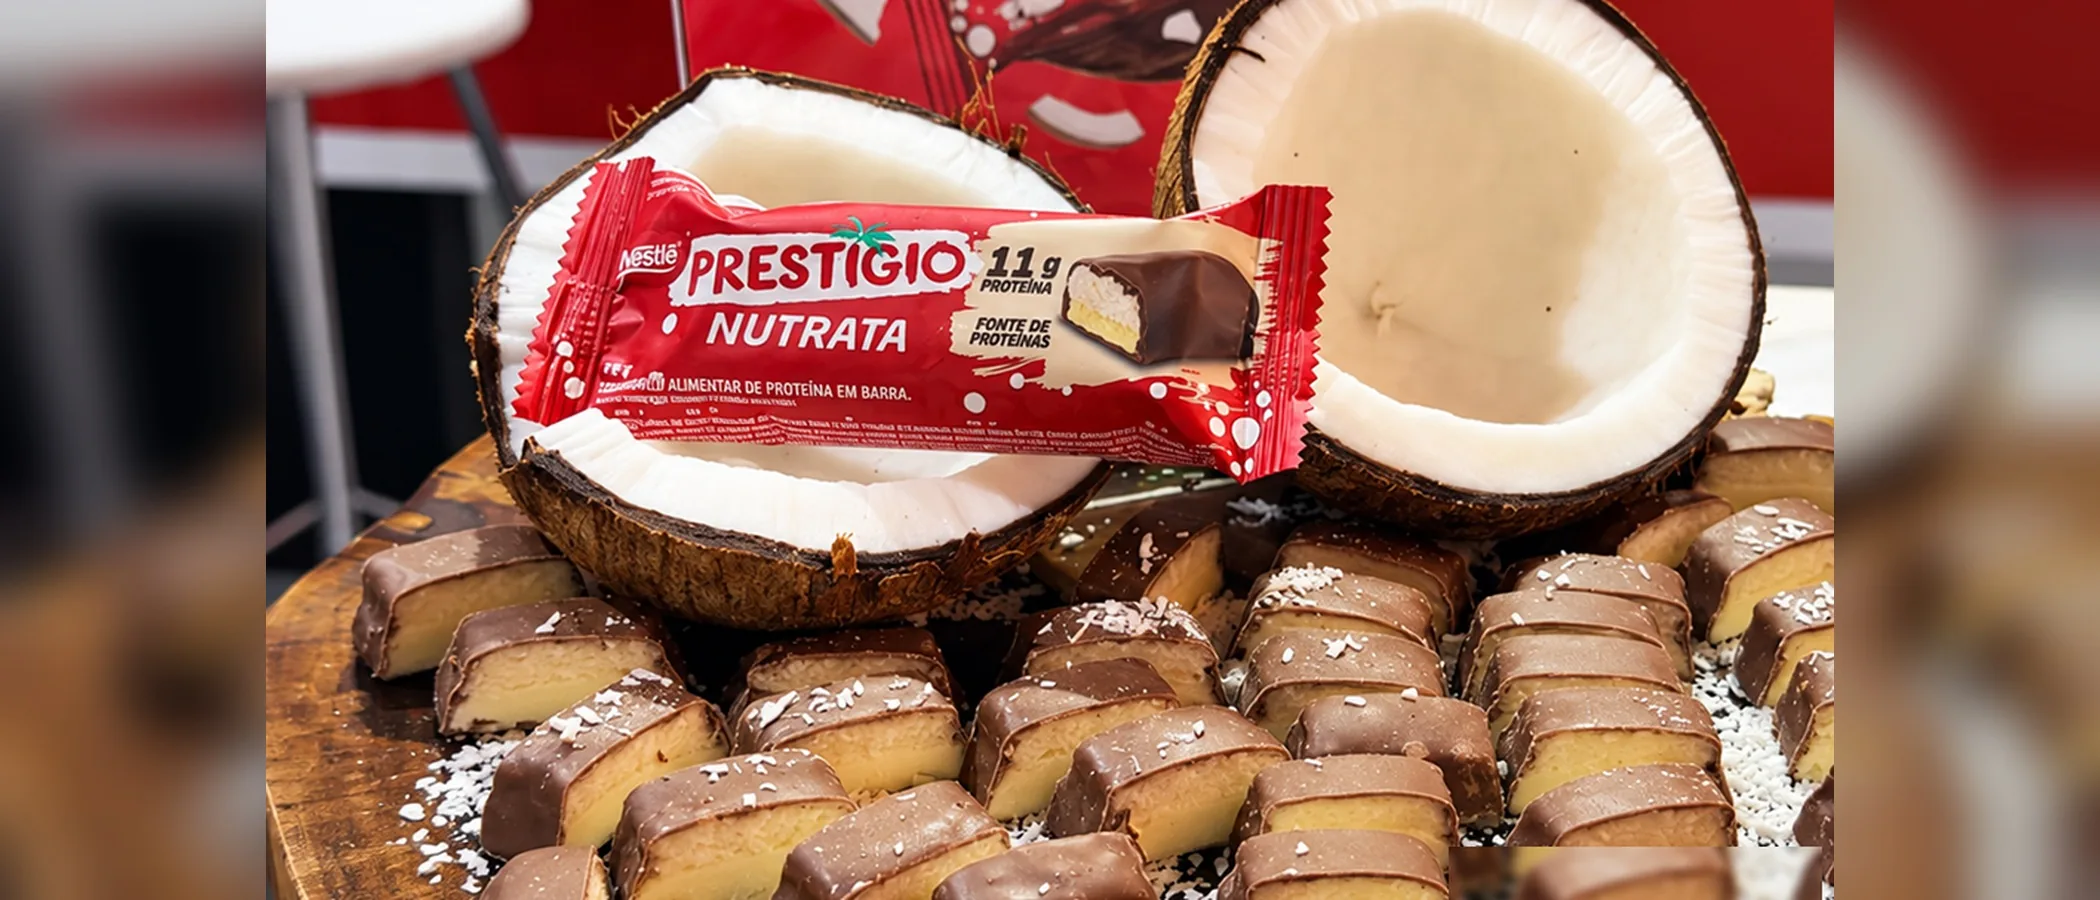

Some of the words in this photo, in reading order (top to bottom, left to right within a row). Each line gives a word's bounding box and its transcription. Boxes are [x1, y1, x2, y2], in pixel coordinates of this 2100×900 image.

[986, 246, 1035, 278] 11
[1041, 256, 1062, 280] g
[980, 278, 1052, 295] PROTEÍNA
[706, 311, 907, 352] NUTRATA
[975, 317, 1028, 332] FONTE
[1028, 319, 1052, 333] DE
[969, 330, 1051, 349] PROTEÍNAS
[667, 378, 742, 394] ALIMENTAR
[744, 382, 763, 396] DE
[766, 380, 834, 398] PROTEÍNA
[837, 384, 858, 399] EM
[861, 385, 912, 401] BARRA.
